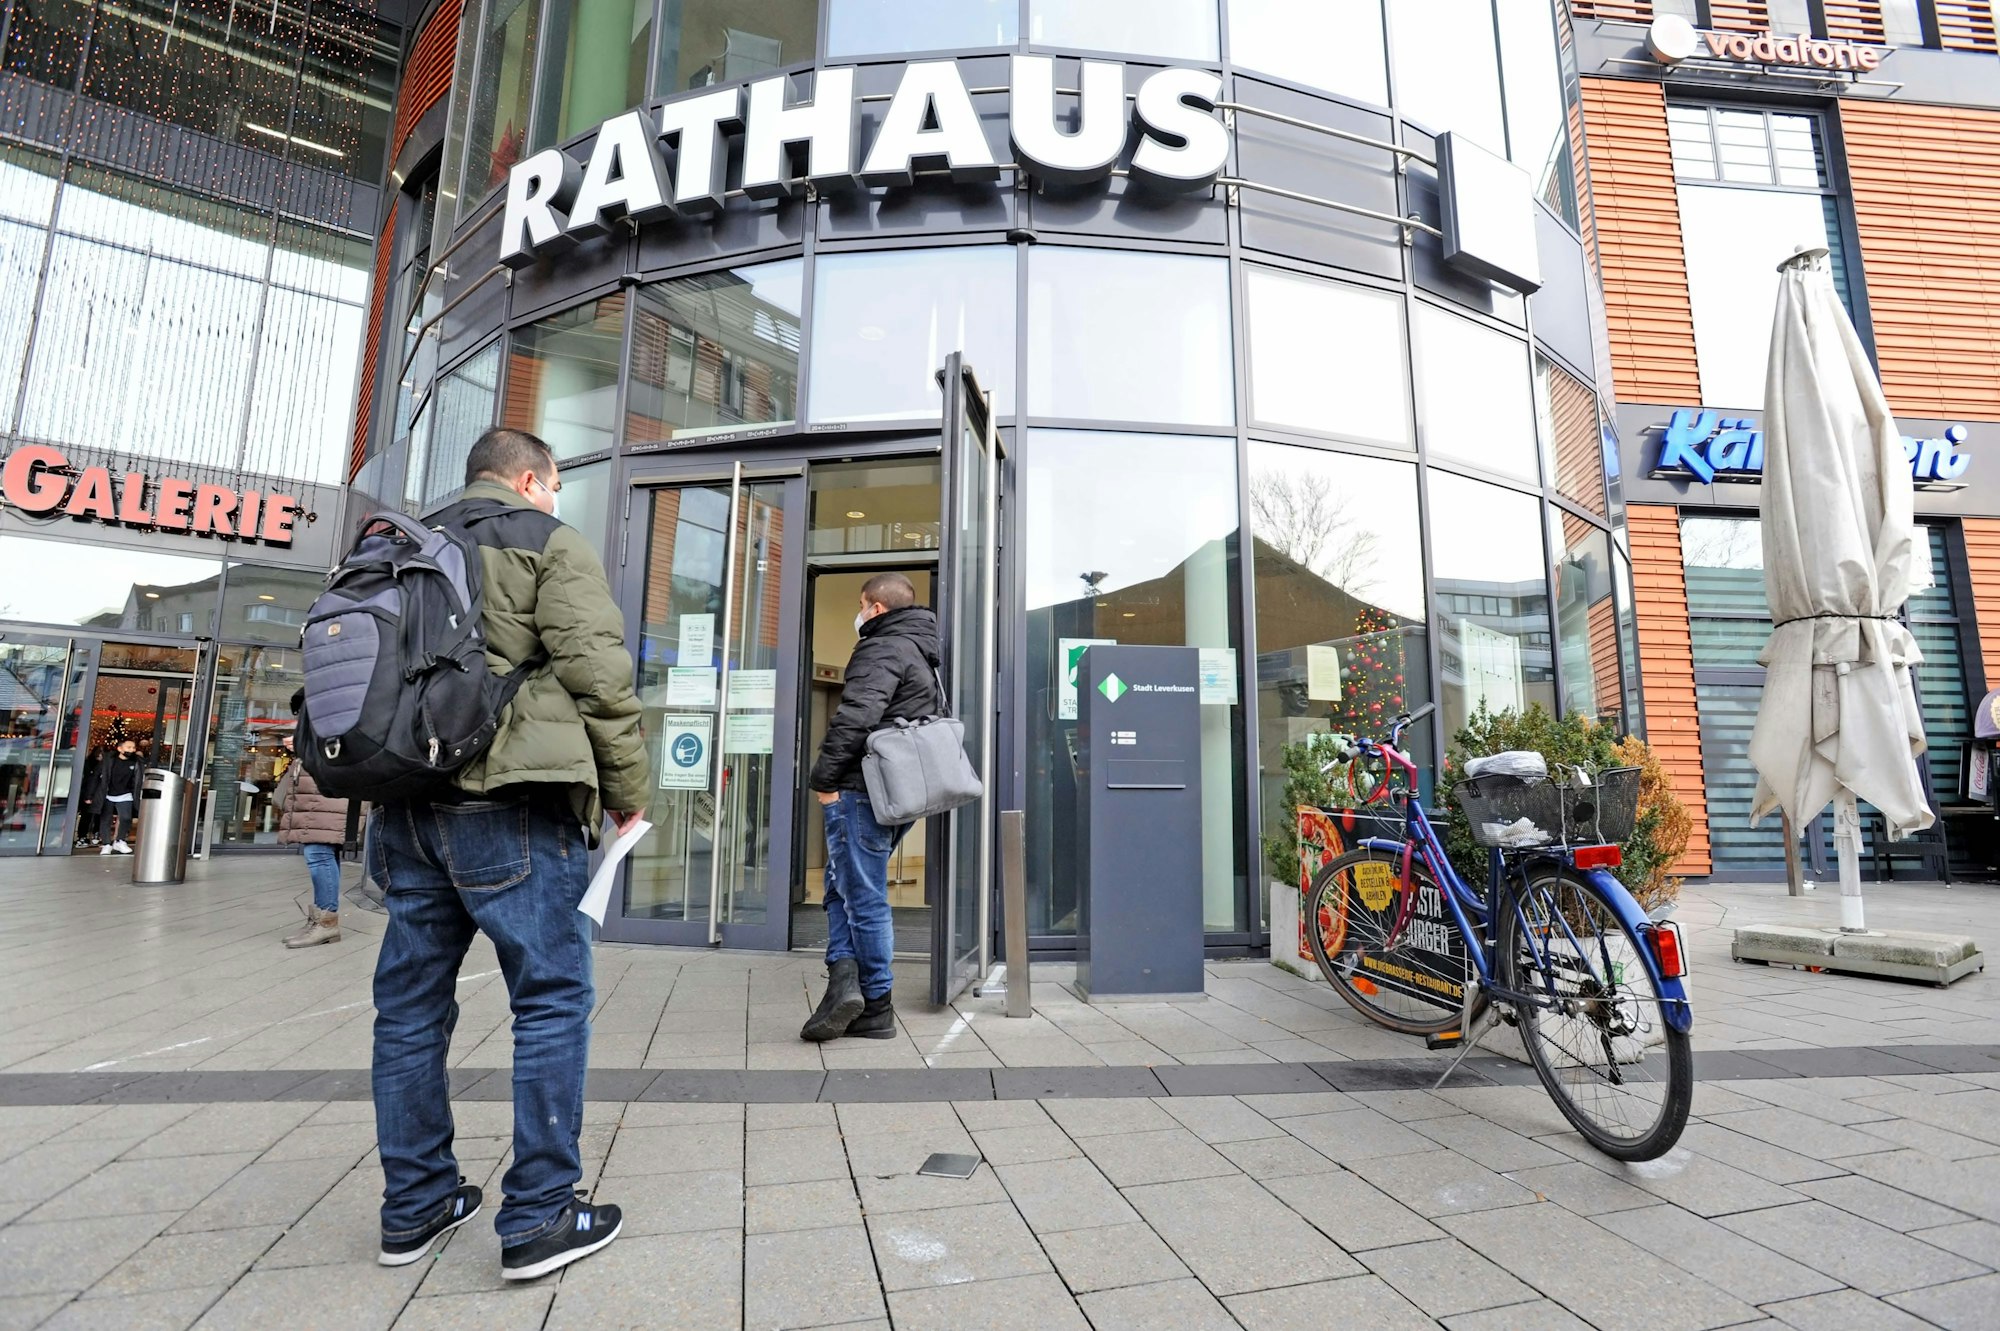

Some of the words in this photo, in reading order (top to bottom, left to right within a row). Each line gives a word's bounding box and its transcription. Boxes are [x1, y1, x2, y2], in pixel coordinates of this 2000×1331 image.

[1704, 31, 1880, 71] vodafone
[499, 53, 1230, 266] RATHAUS
[2, 444, 296, 542] GALERIE
[1133, 684, 1153, 692] Stadt
[1154, 684, 1195, 693] Leverkusen
[668, 719, 709, 728] Maskenpflicht
[1361, 877, 1385, 889] BESTELLEN
[1365, 890, 1387, 901] ABHOLEN
[576, 1212, 591, 1231] N
